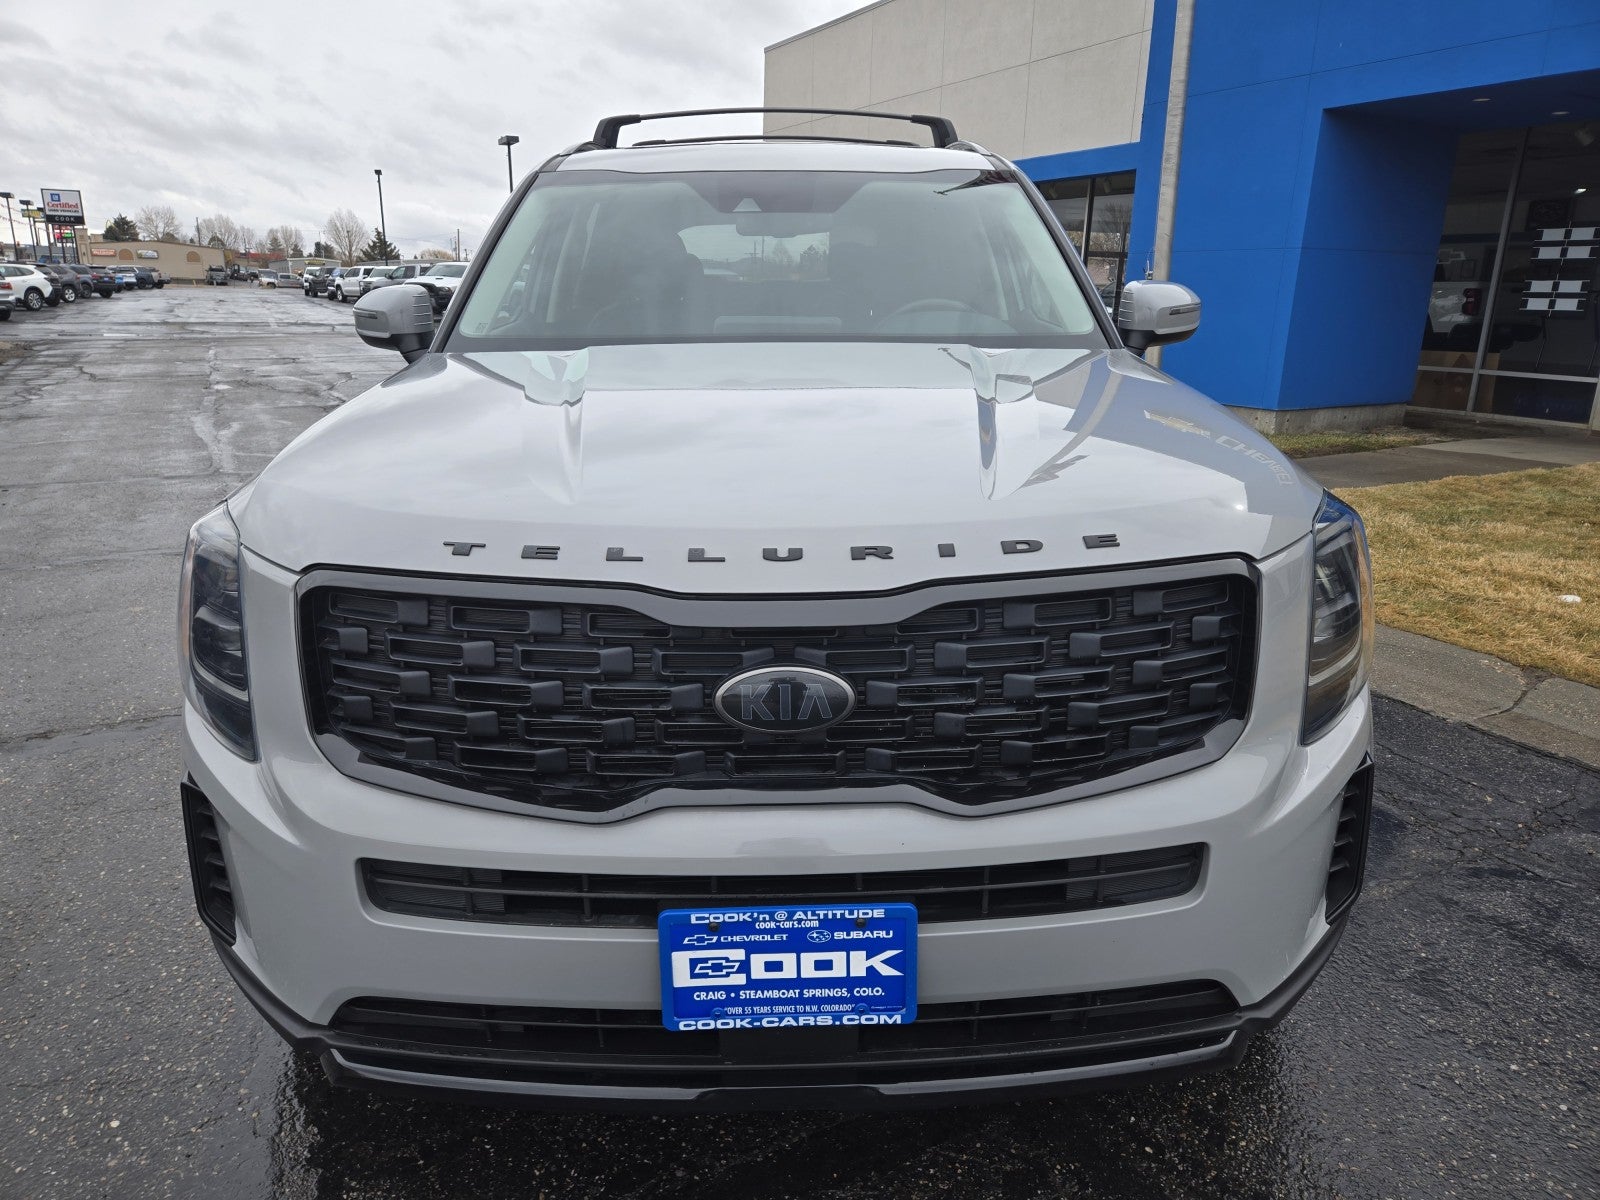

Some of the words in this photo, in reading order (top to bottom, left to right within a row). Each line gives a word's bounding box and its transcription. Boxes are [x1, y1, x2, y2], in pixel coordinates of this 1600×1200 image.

[47, 201, 79, 209] Certified
[443, 533, 1121, 562] TELLURIDE
[739, 683, 833, 721] KIA
[690, 912, 770, 924] COOK'n
[774, 910, 788, 921] @
[792, 909, 885, 920] ALTITUDE
[755, 919, 819, 929] cook-cars.com
[720, 933, 788, 943] CHEVROLET
[834, 930, 893, 940] SUBARU
[671, 948, 904, 988] COOK
[693, 990, 727, 1001] CRAIG
[739, 989, 800, 999] STEAMBOAT
[803, 988, 851, 998] SPRINGS,
[853, 987, 885, 996] COLO.
[744, 1006, 752, 1014] 55
[753, 1006, 771, 1014] YEARS
[772, 1005, 795, 1013] SERVICE
[796, 1005, 804, 1013] TO
[678, 1014, 902, 1031] COOK-CARS.COM
